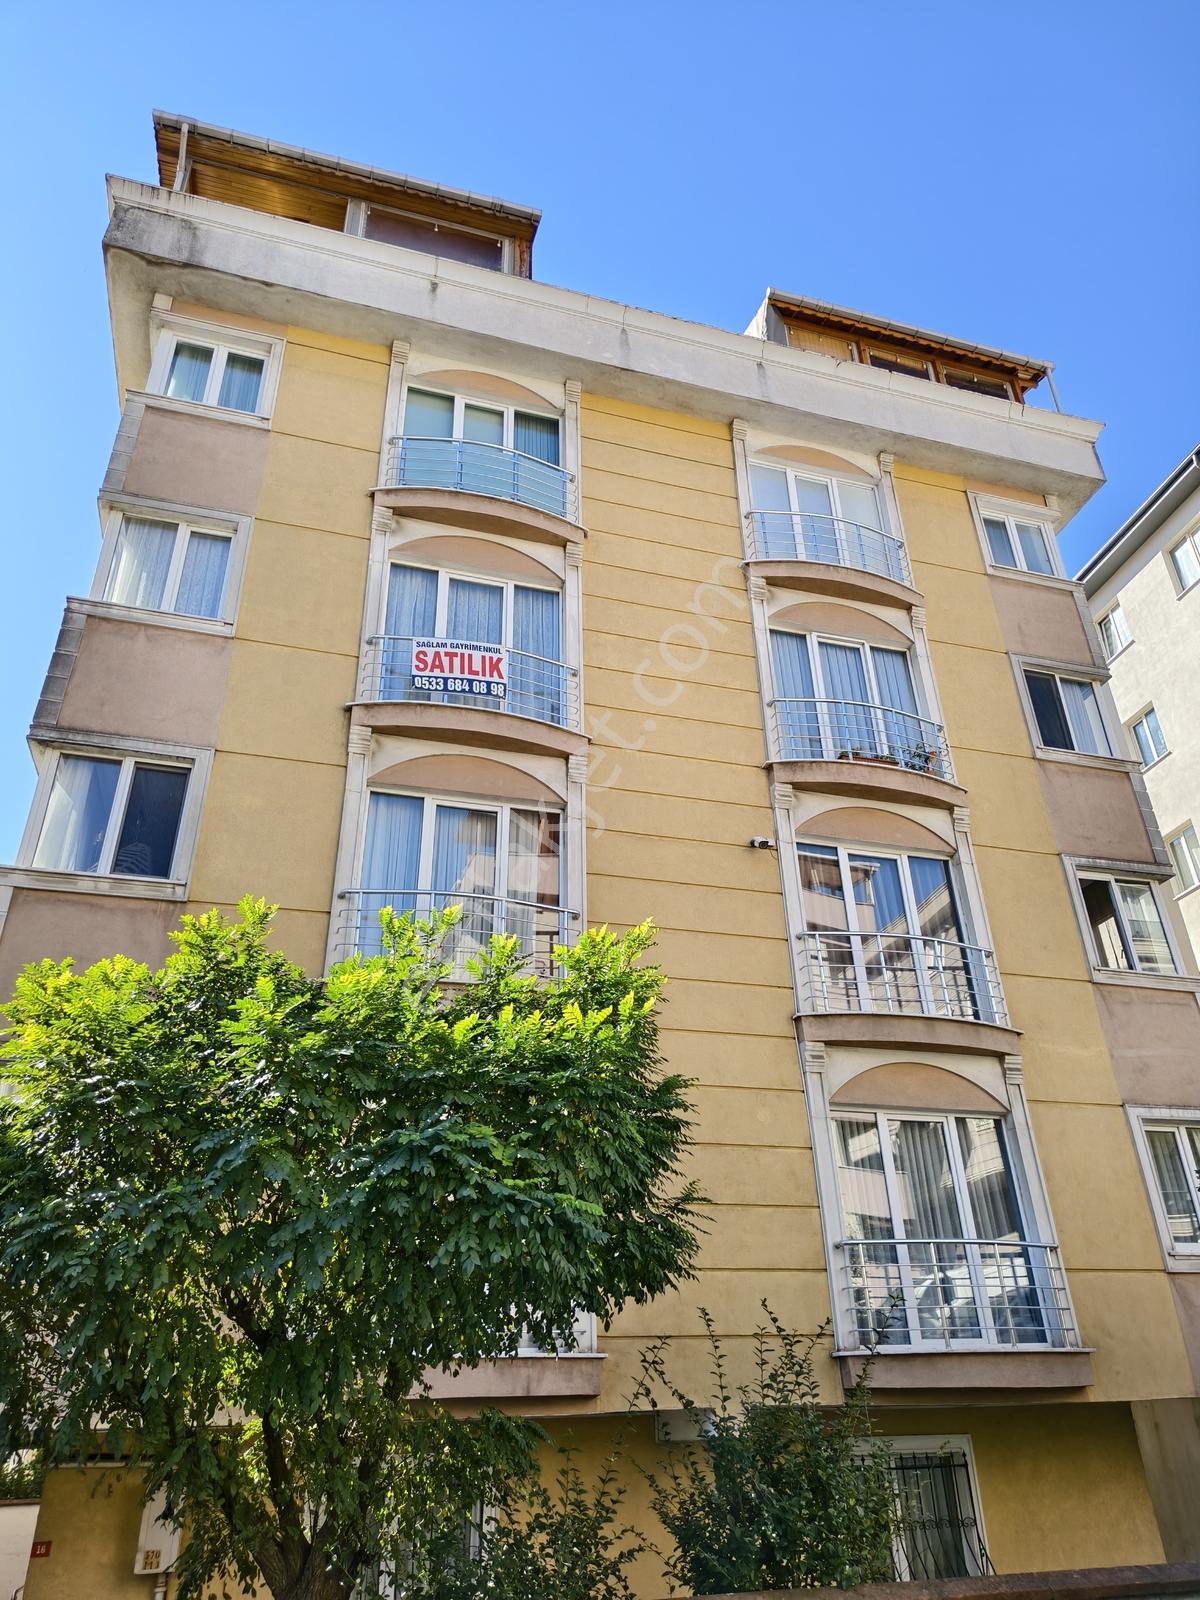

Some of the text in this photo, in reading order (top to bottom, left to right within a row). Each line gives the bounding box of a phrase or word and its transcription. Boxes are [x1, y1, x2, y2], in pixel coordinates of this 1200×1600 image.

[450, 642, 503, 654] GAYRİMENKUL
[415, 650, 504, 679] SATILIK
[414, 677, 505, 697] 0533 684 08 98
